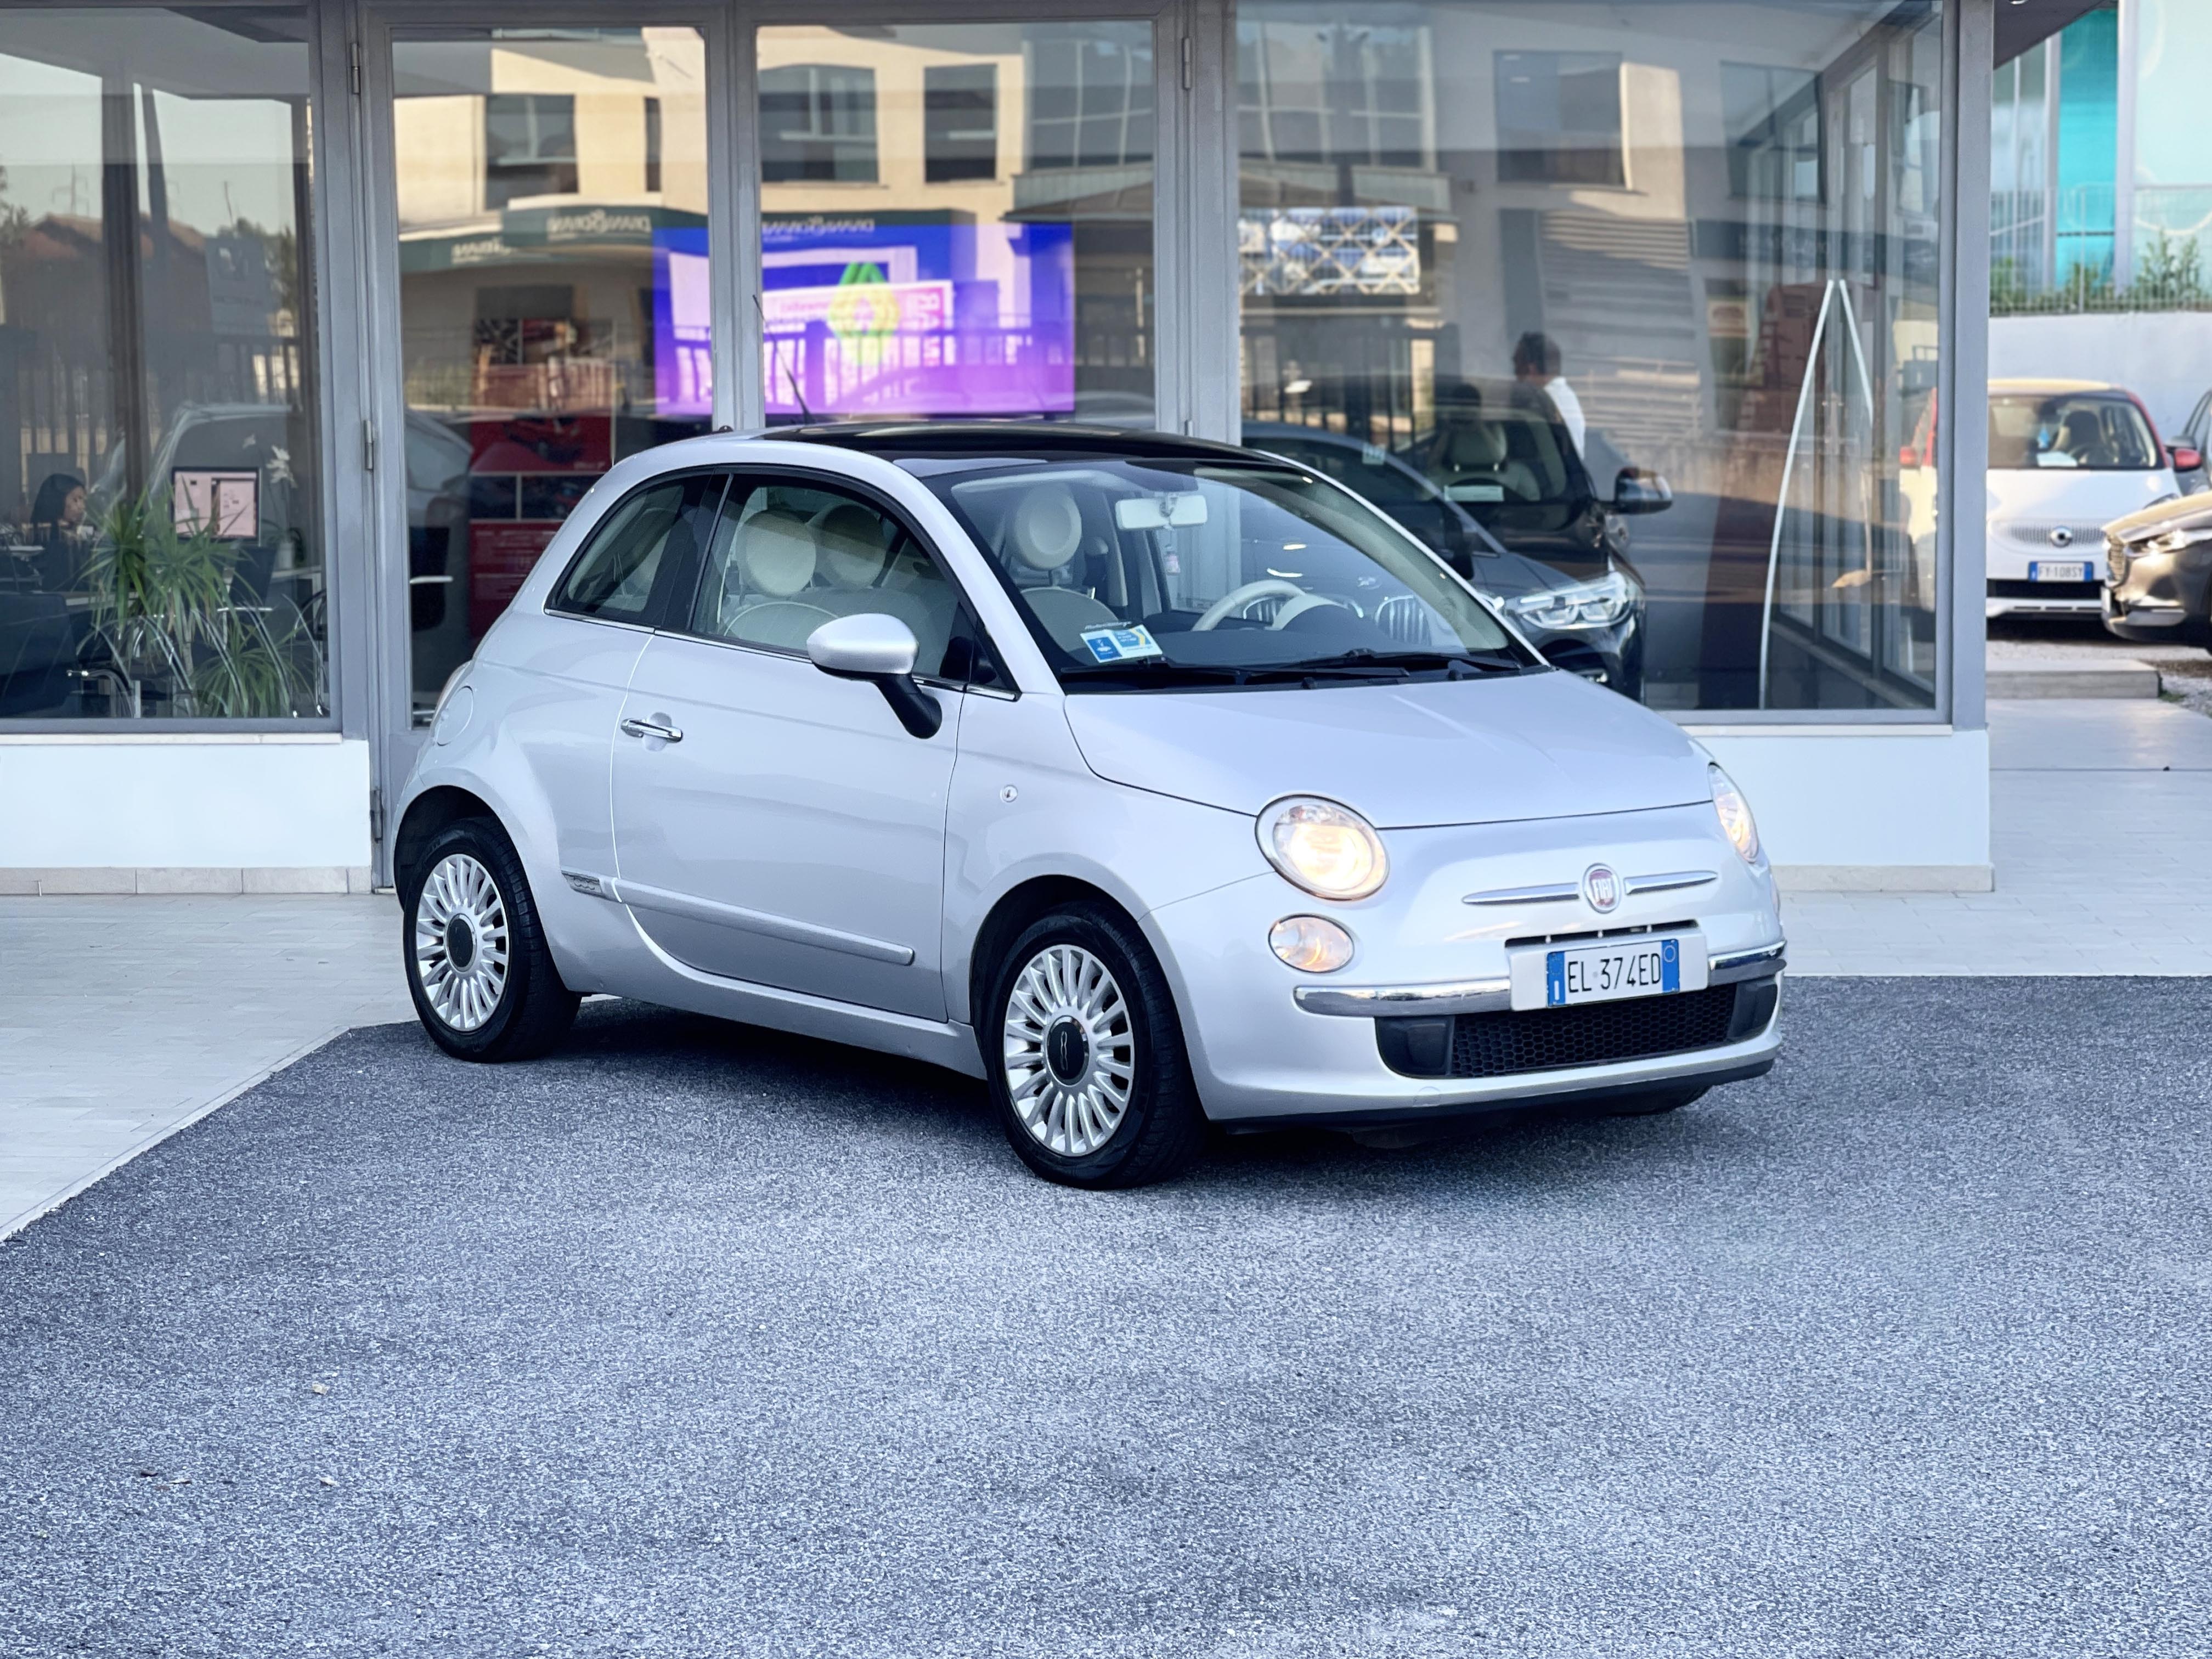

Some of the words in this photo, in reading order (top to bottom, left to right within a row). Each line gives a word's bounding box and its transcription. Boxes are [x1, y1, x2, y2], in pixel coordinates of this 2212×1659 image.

[1592, 878, 1613, 901] FIAT
[1567, 961, 1592, 994] EL
[1600, 952, 1662, 990] 374ED
